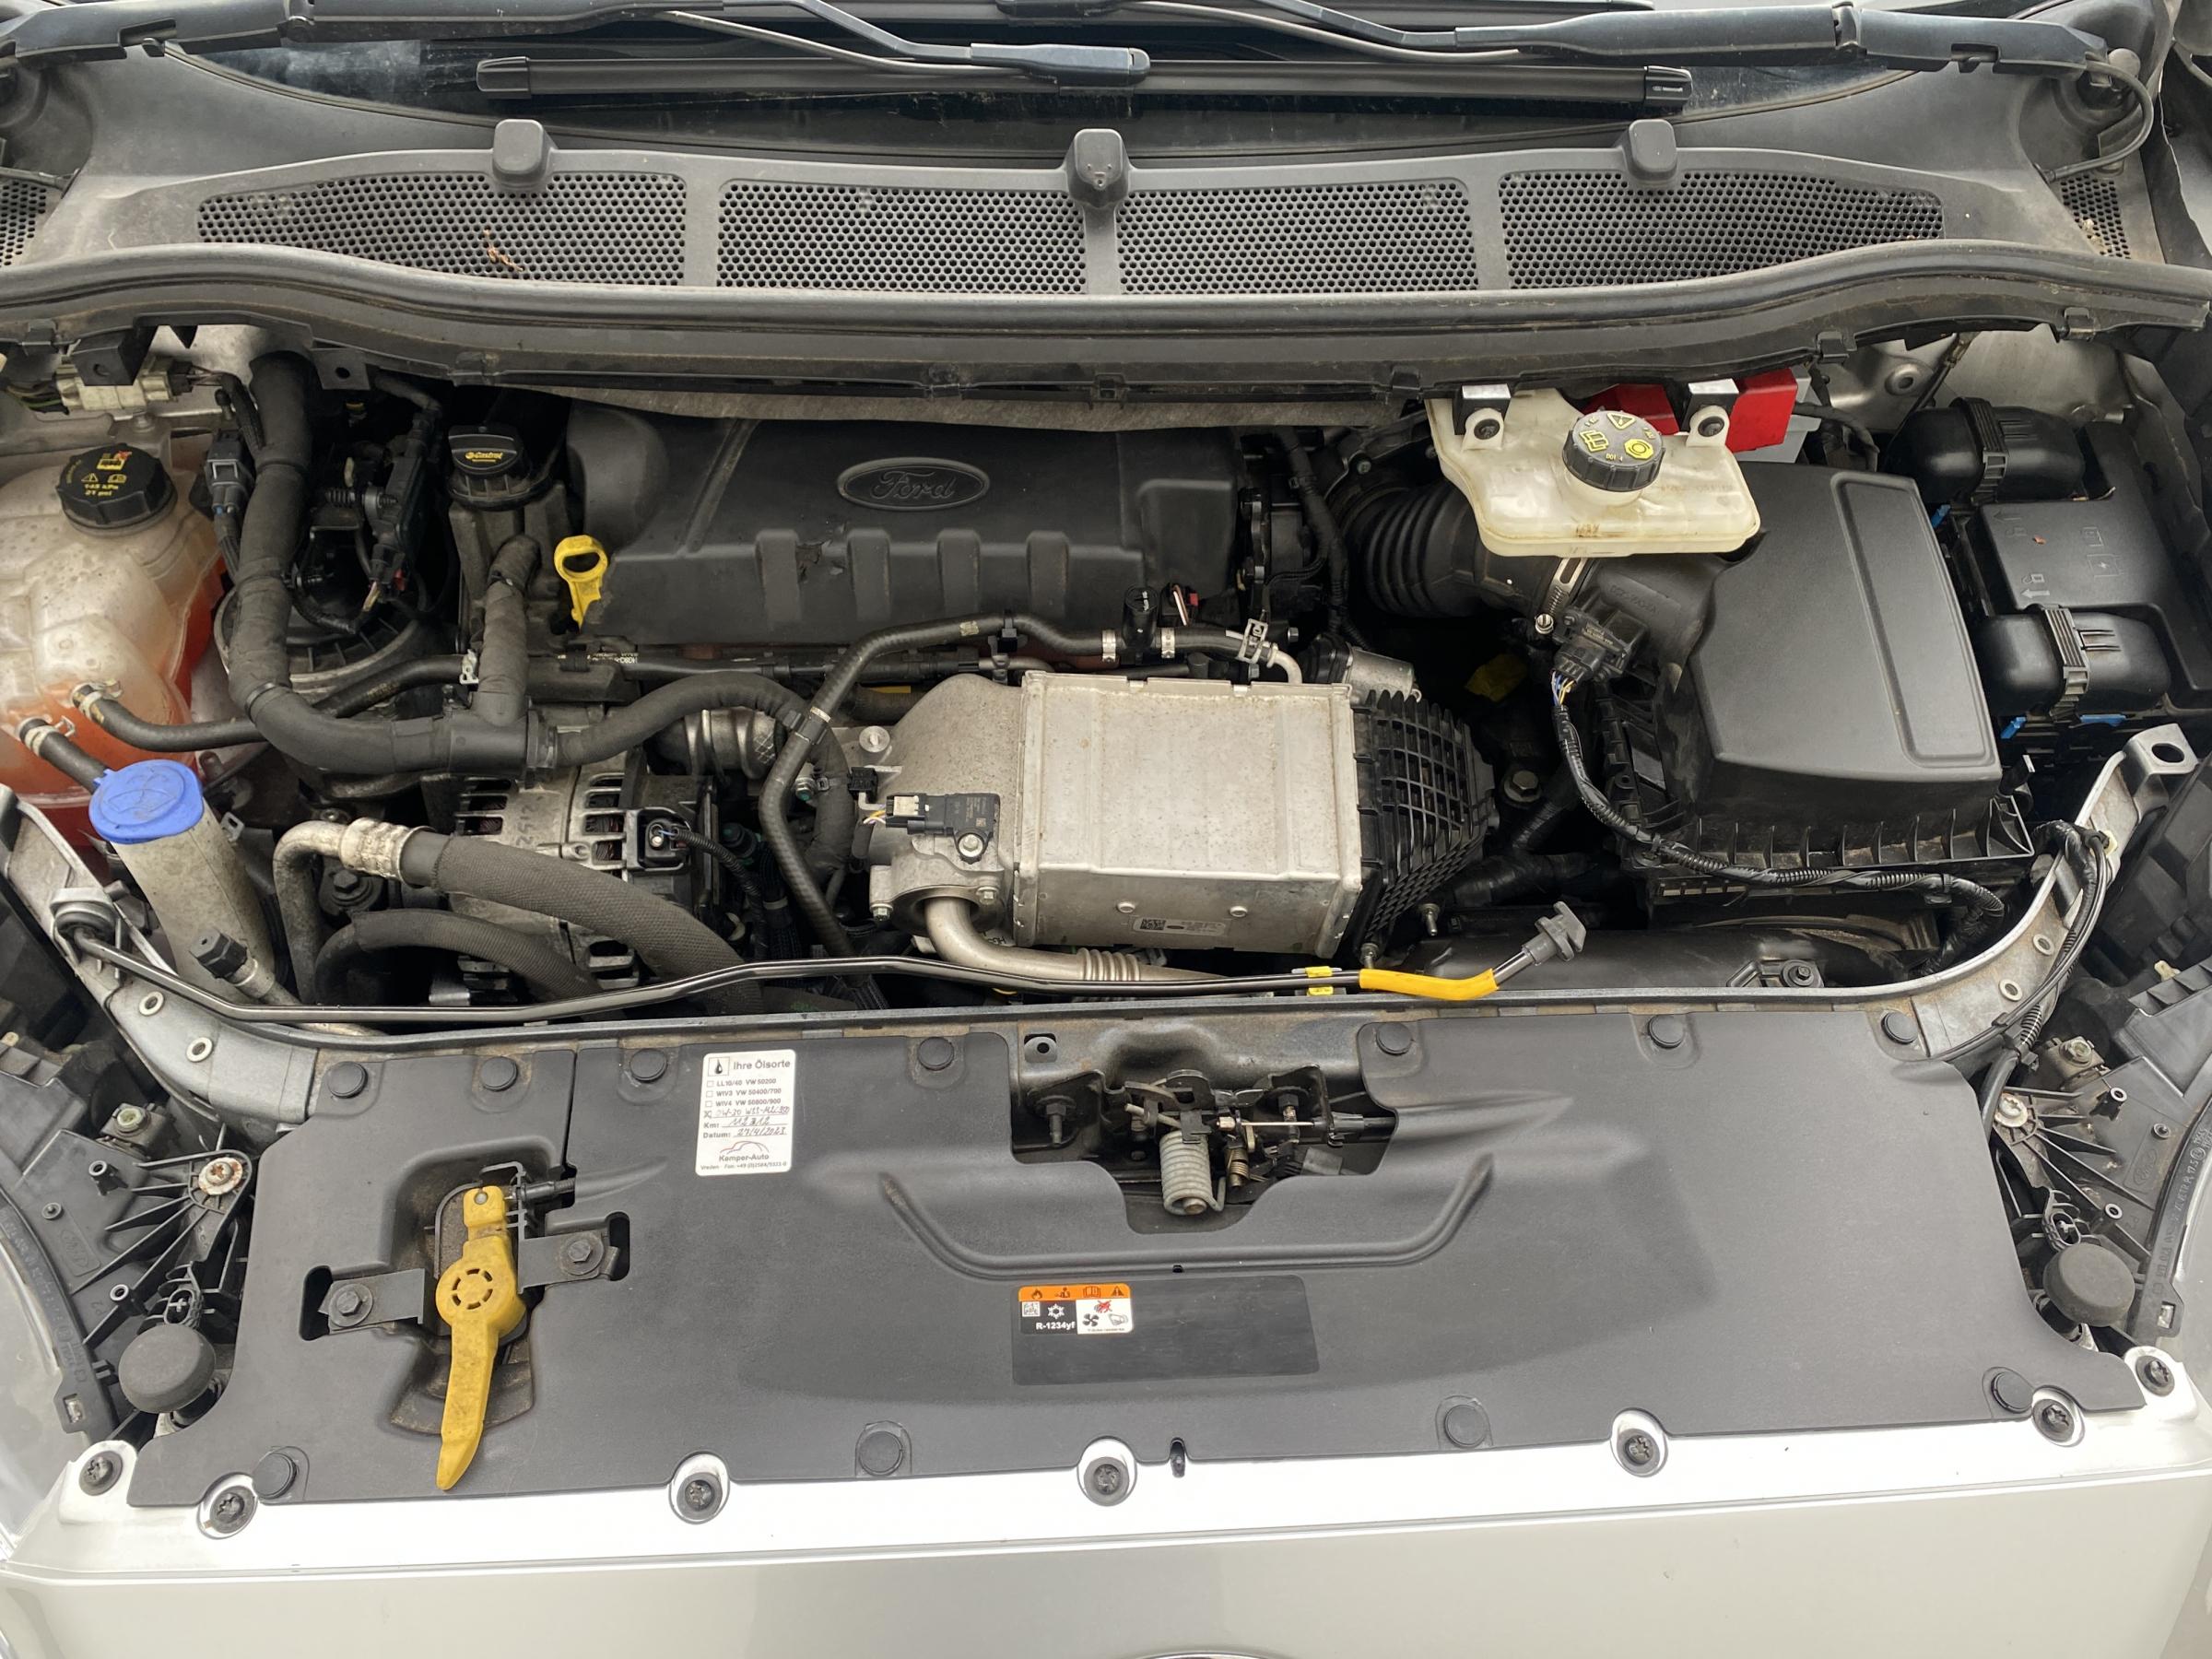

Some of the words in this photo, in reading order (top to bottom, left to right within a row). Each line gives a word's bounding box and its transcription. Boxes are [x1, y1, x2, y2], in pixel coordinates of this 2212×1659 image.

[870, 470, 956, 500] Ford
[733, 1060, 753, 1070] Ihre
[755, 1058, 791, 1069] Ölsorte
[719, 1154, 770, 1163] Kemper-Auto
[1035, 1321, 1076, 1330] R-1234yf
